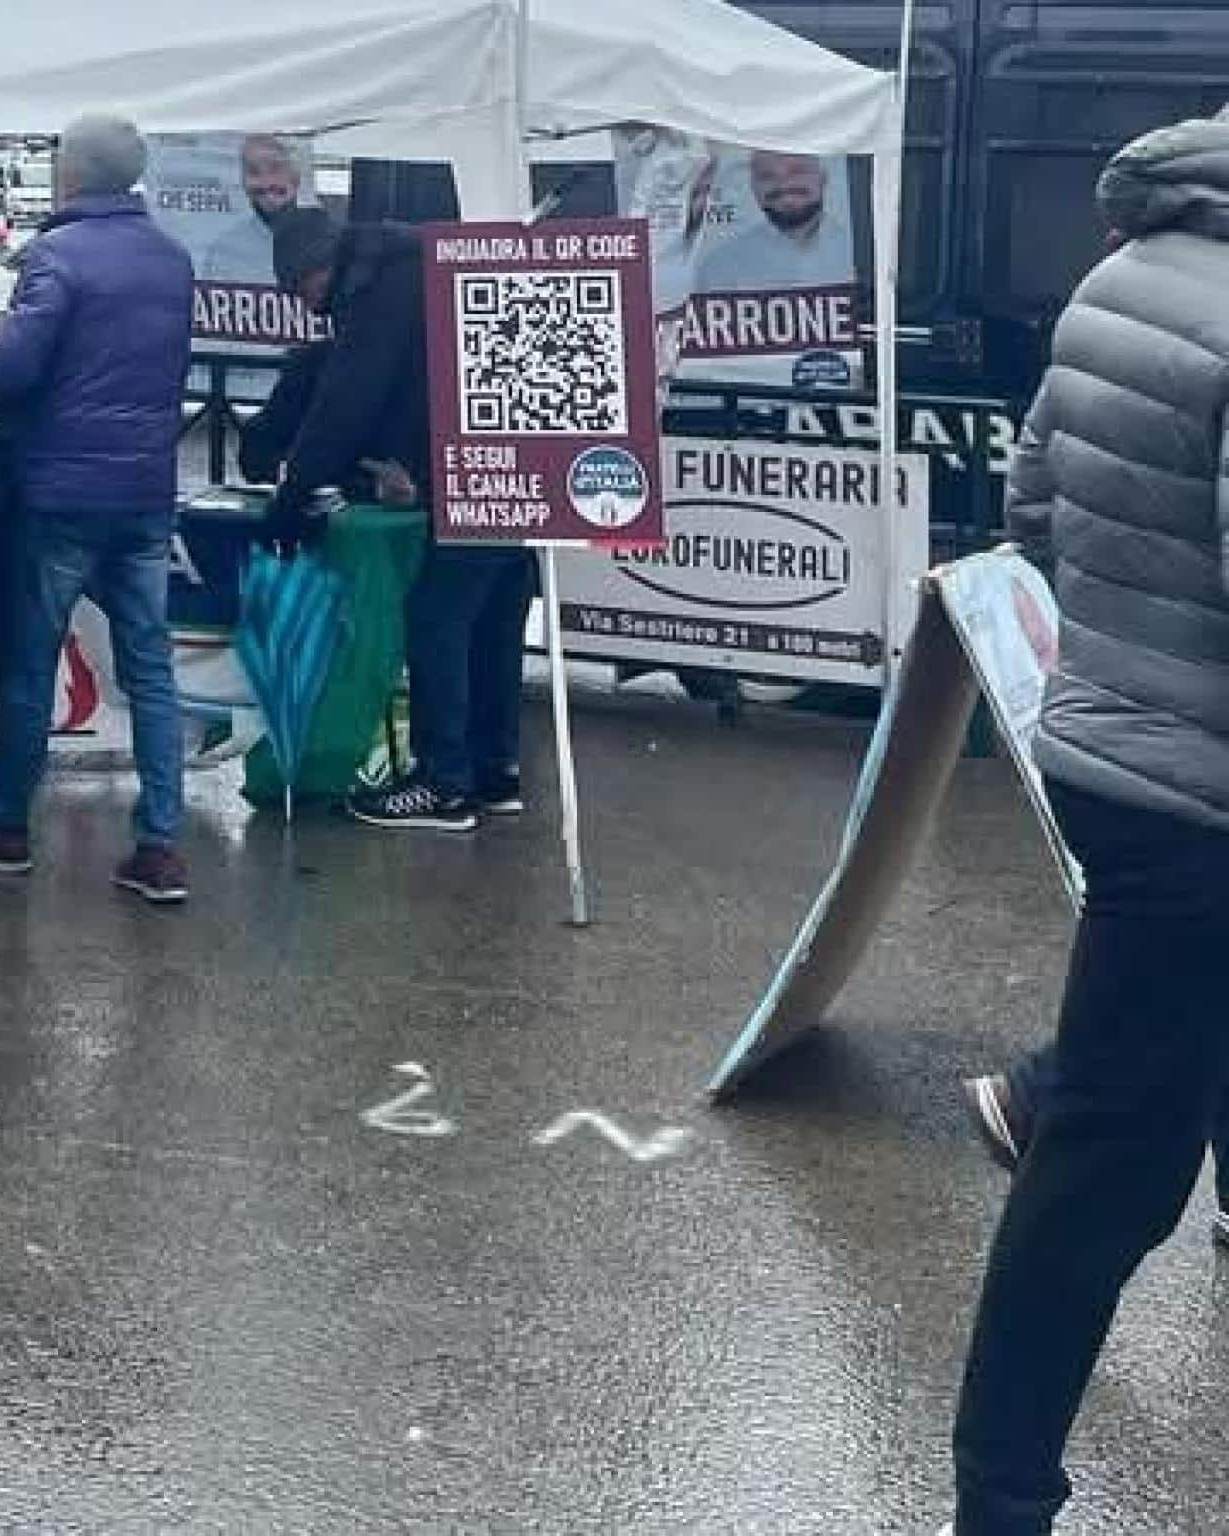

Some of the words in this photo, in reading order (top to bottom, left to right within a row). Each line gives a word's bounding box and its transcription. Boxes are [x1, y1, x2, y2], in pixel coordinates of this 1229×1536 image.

[436, 238, 526, 263] INQUADRA
[532, 238, 551, 261] IL
[556, 235, 582, 261] QR
[586, 234, 639, 260] CODE
[446, 446, 458, 469] E
[462, 445, 516, 469] SEGUI
[447, 473, 465, 497] IL
[468, 473, 543, 499] CANALE
[676, 450, 909, 506] FUNERARIA
[447, 501, 550, 526] WHATSAPP
[580, 609, 613, 632] Via
